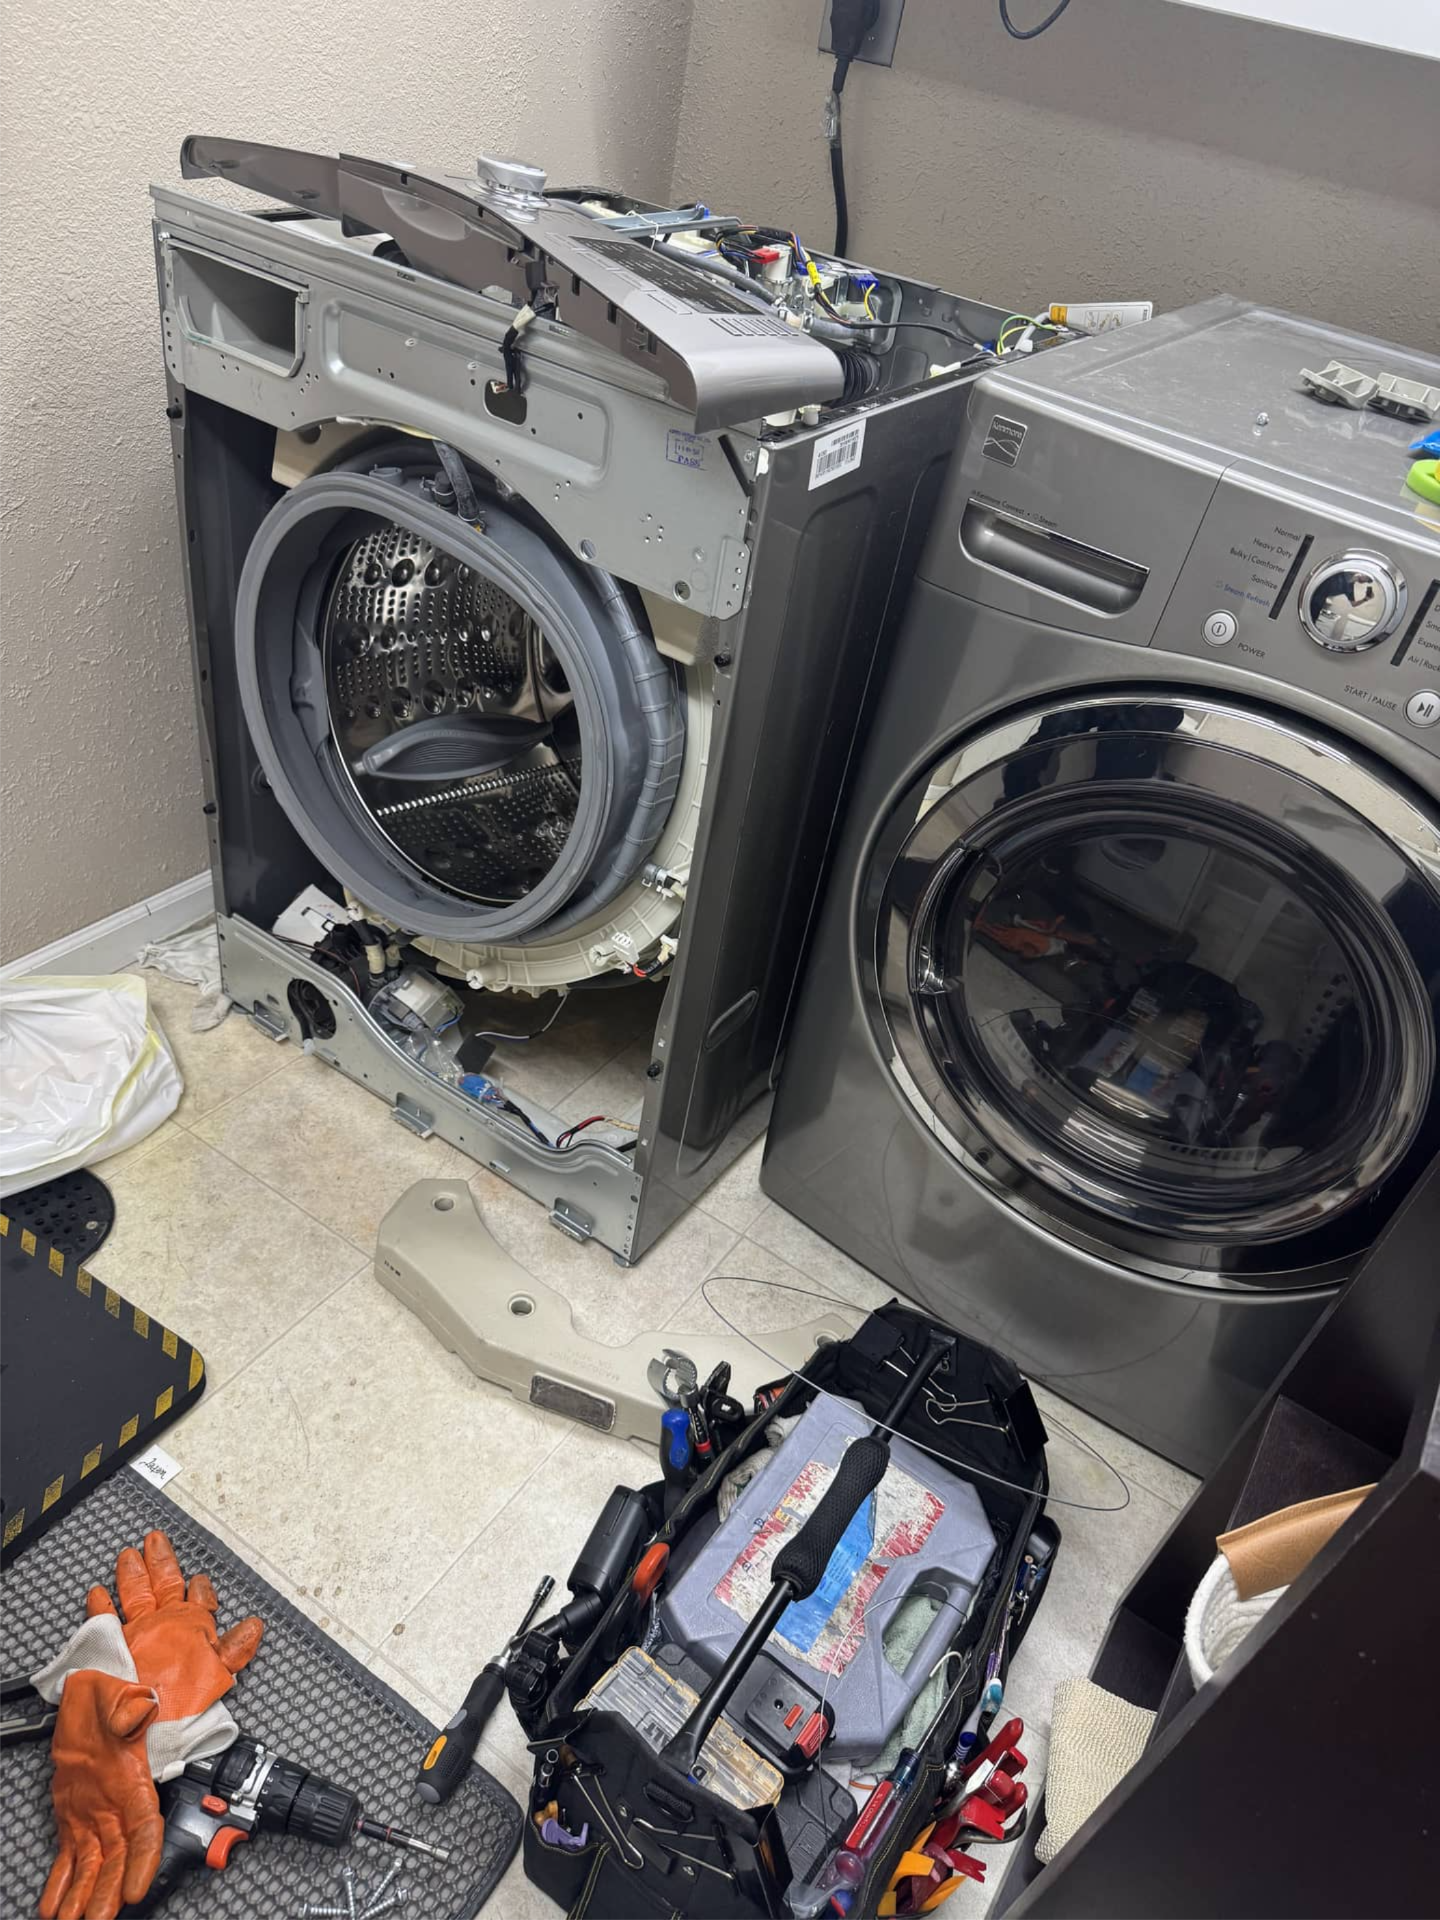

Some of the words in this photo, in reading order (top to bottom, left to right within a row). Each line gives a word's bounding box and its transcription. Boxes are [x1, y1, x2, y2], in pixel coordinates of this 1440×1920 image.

[993, 421, 1022, 438] Kenmore
[1274, 526, 1301, 541] Normal
[1253, 537, 1276, 552] Heavy
[1276, 546, 1293, 559] Duty
[1250, 574, 1278, 590] Sanitize
[1224, 583, 1245, 596] Steam
[1246, 592, 1271, 608] Refresh
[1237, 642, 1266, 658] POWER
